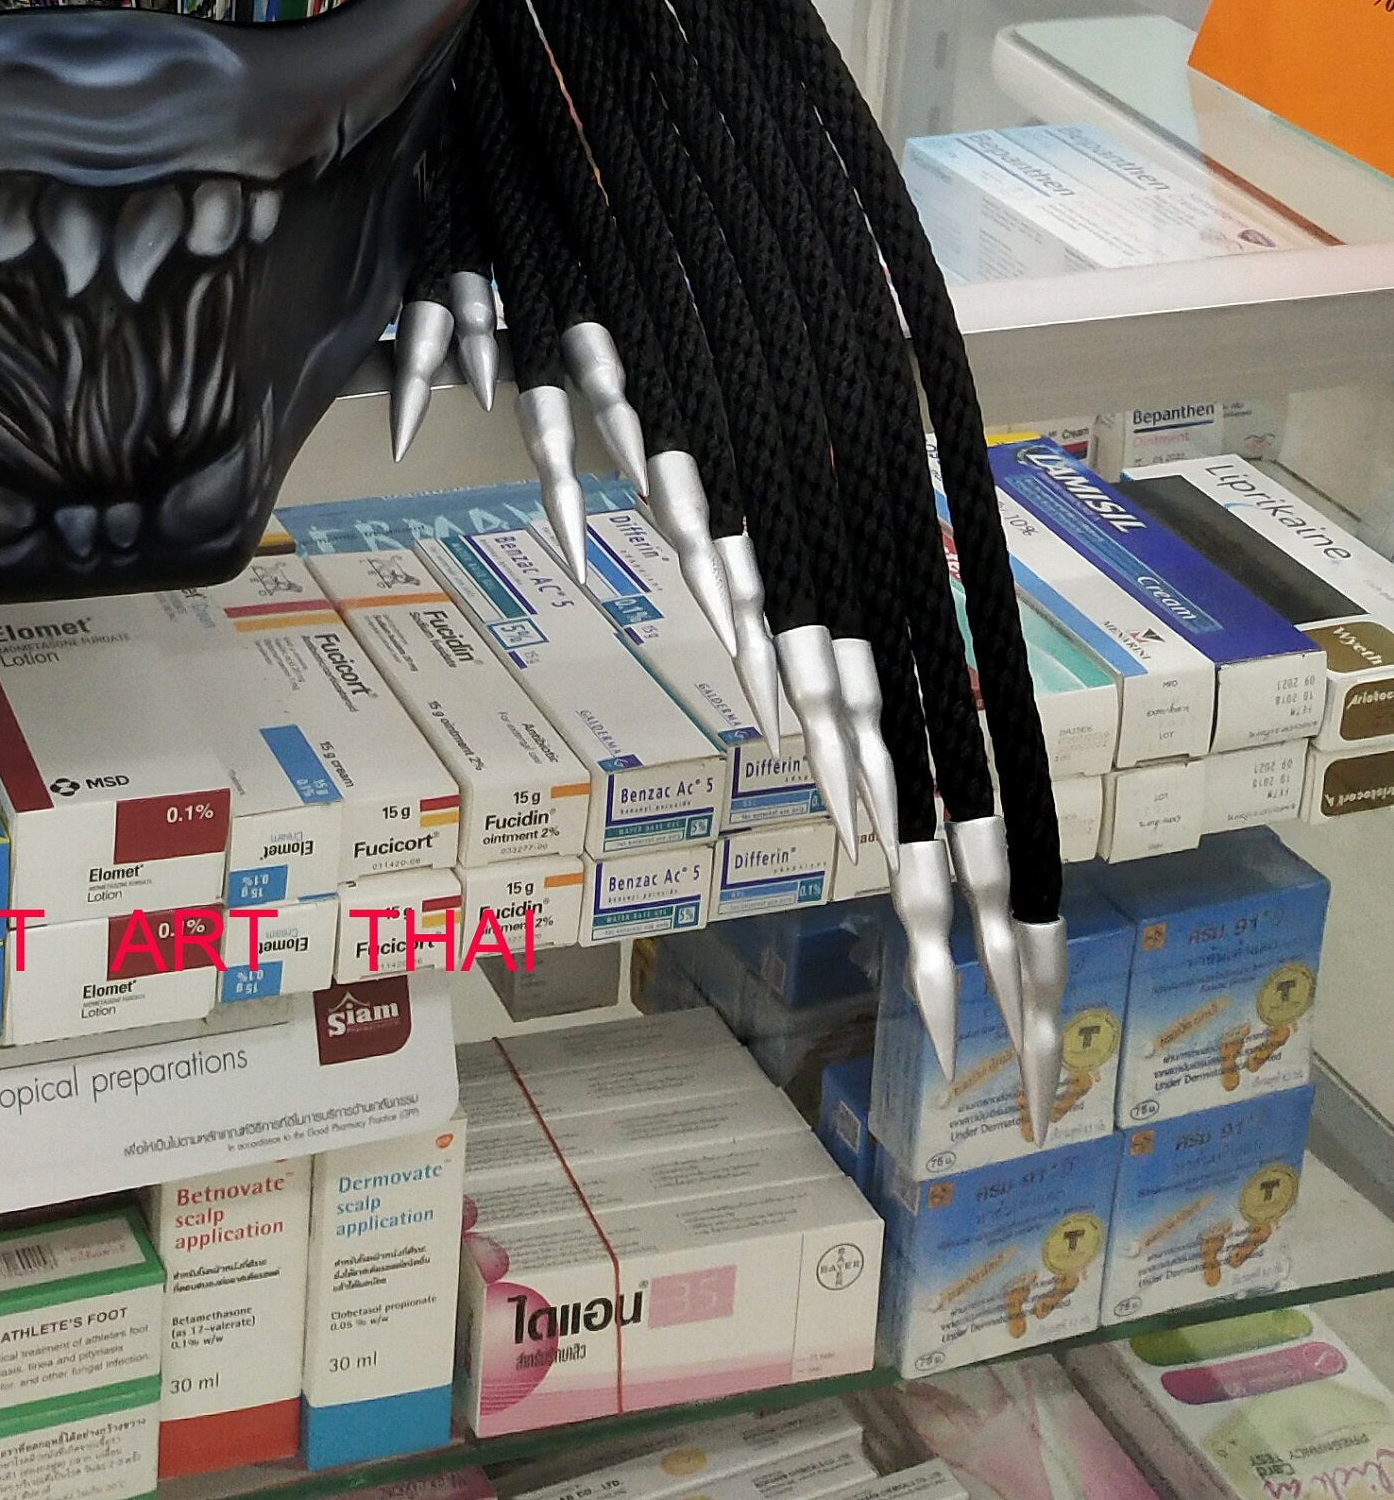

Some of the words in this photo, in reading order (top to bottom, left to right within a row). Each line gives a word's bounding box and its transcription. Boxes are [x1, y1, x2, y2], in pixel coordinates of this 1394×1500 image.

[966, 132, 1076, 198] Bepanthen
[1053, 125, 1171, 193] Bepanthen
[1132, 402, 1216, 426] Bepanthen
[1026, 451, 1147, 534] LAMISIL
[1205, 462, 1353, 563] Liprikaine
[608, 513, 663, 562] Differin
[1005, 513, 1040, 538] 10%
[494, 535, 540, 576] Benzac
[1136, 574, 1199, 622] Cream
[423, 609, 476, 663] Fucidin
[1333, 625, 1384, 667] Wyeth
[0, 649, 60, 668] Lotion
[314, 631, 372, 697] Fucicort
[440, 716, 475, 758] ointment
[331, 760, 355, 789] cream
[745, 756, 801, 780] Differin
[86, 774, 130, 791] MSD
[620, 784, 672, 805] Benzac
[706, 777, 715, 794] 5
[513, 791, 527, 805] 15
[531, 792, 542, 806] g
[166, 803, 214, 824] 0.1%
[381, 806, 396, 820] 15
[400, 806, 411, 821] g
[485, 811, 550, 831] Fucidin
[263, 839, 314, 859] Elomet
[354, 834, 434, 859] Fucicort
[483, 830, 539, 846] ointment
[734, 851, 790, 871] Differin
[89, 865, 140, 884] Elomet
[608, 873, 659, 894] Benzac
[692, 865, 701, 881] 5
[87, 887, 123, 903] Lotion
[799, 882, 823, 898] 0.1%
[258, 935, 309, 955] Elomet
[82, 980, 134, 1000] Elomet
[81, 1003, 117, 1020] Lotion
[326, 999, 400, 1039] Siam
[92, 1045, 249, 1103] preparations
[338, 1161, 444, 1195] Dermovate
[176, 1176, 286, 1208] Betnovate
[336, 1195, 382, 1216] scalp
[174, 1207, 225, 1230] scalp
[336, 1207, 435, 1239] application
[174, 1219, 285, 1252] application
[171, 1305, 254, 1328] Betamethasone
[330, 1303, 382, 1322] Clobetasol
[384, 1294, 438, 1314] propionate
[507, 1290, 645, 1346] ไดแอน
[0, 1317, 85, 1346] ATHLETE'S
[87, 1306, 130, 1327] FOOT
[328, 1356, 351, 1374] 30
[356, 1351, 378, 1369] ml
[169, 1377, 193, 1395] 30
[198, 1372, 221, 1390] ml
